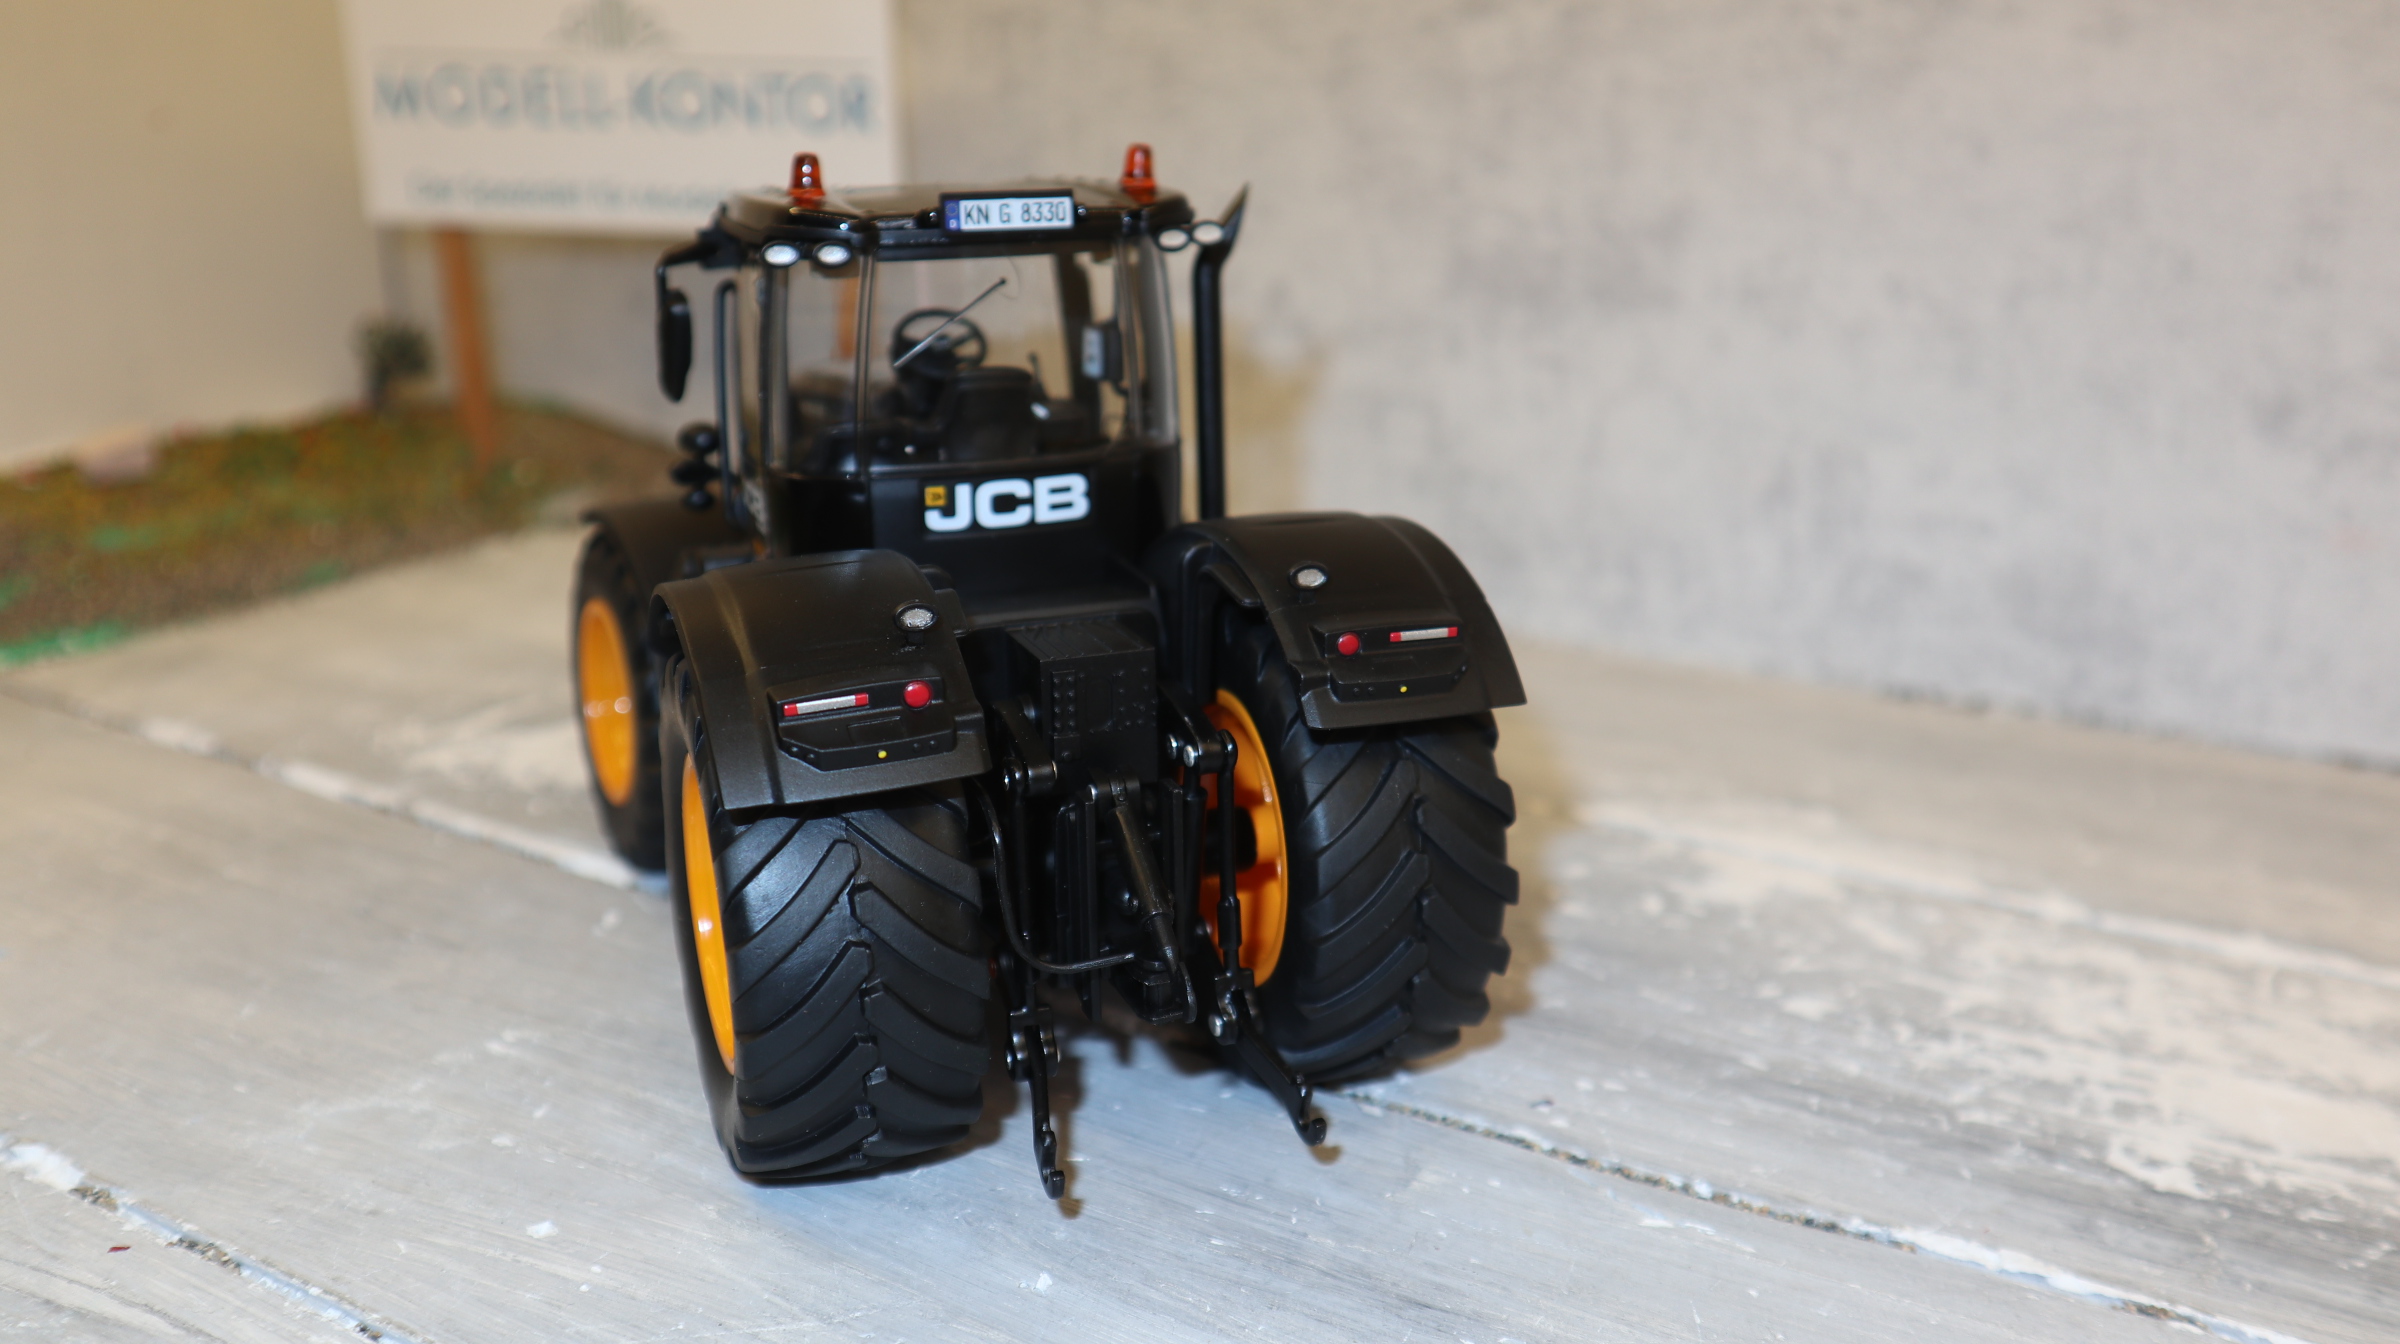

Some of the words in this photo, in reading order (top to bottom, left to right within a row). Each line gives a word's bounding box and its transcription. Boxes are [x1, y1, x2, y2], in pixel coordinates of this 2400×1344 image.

[964, 203, 990, 225] KN
[999, 202, 1011, 224] G
[1021, 201, 1066, 222] 8330
[924, 473, 1091, 533] JCB
